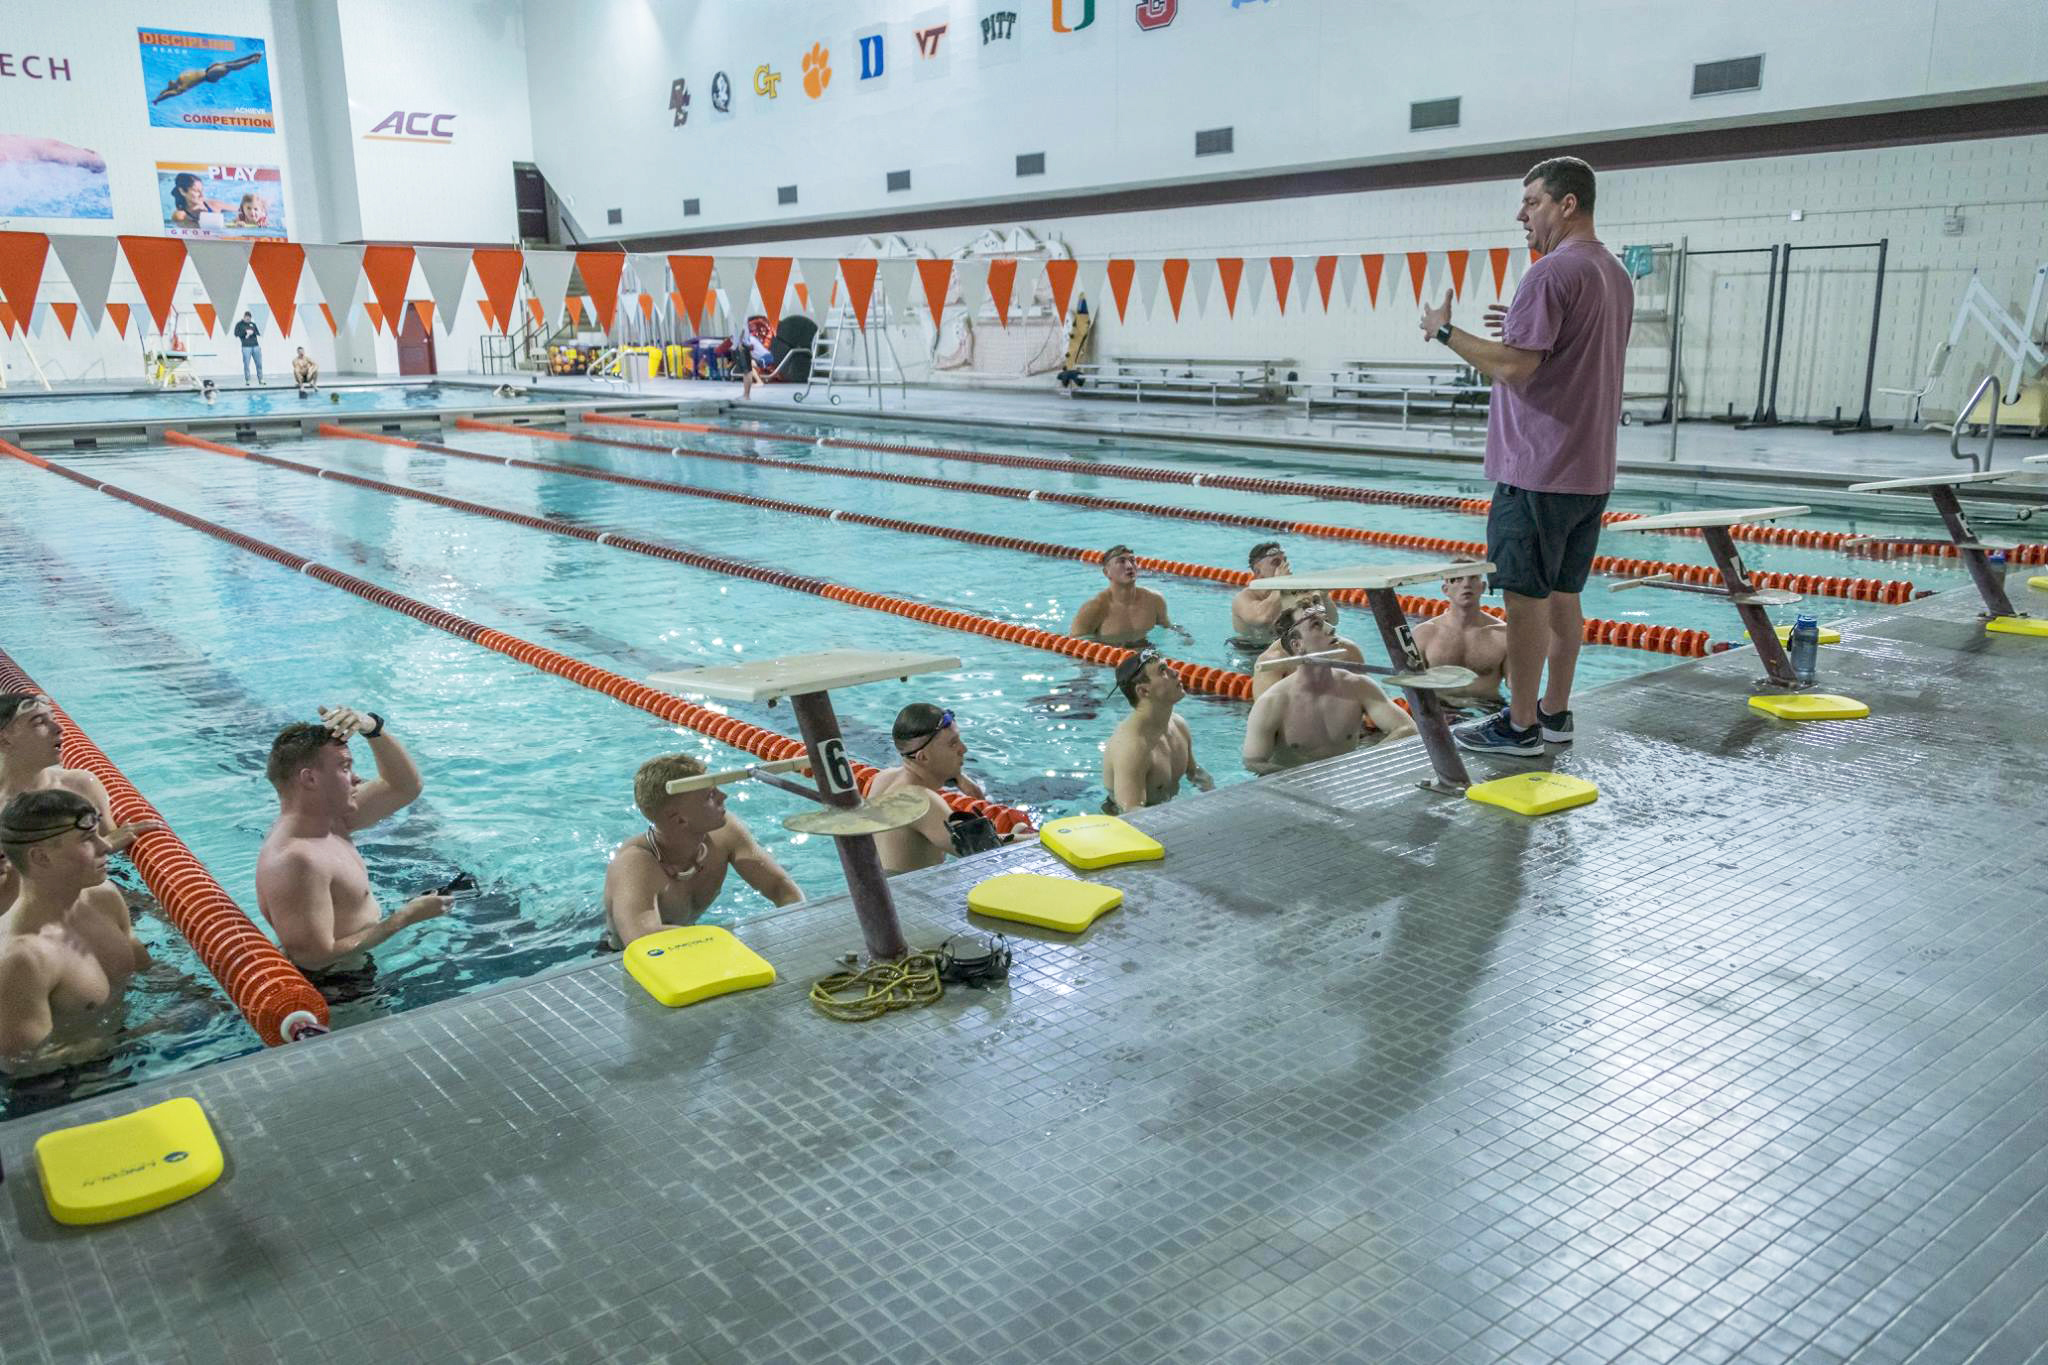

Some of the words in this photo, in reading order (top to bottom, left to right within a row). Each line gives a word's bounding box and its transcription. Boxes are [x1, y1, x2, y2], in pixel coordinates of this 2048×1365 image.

[143, 33, 235, 51] DISCIPL
[914, 25, 947, 57] VT
[980, 11, 1017, 45] PITT
[0, 53, 72, 81] ECH
[753, 64, 782, 98] GT
[183, 114, 272, 128] COMPETITION
[369, 111, 457, 138] ACC
[208, 166, 258, 182] PLAY
[825, 740, 854, 790] 6
